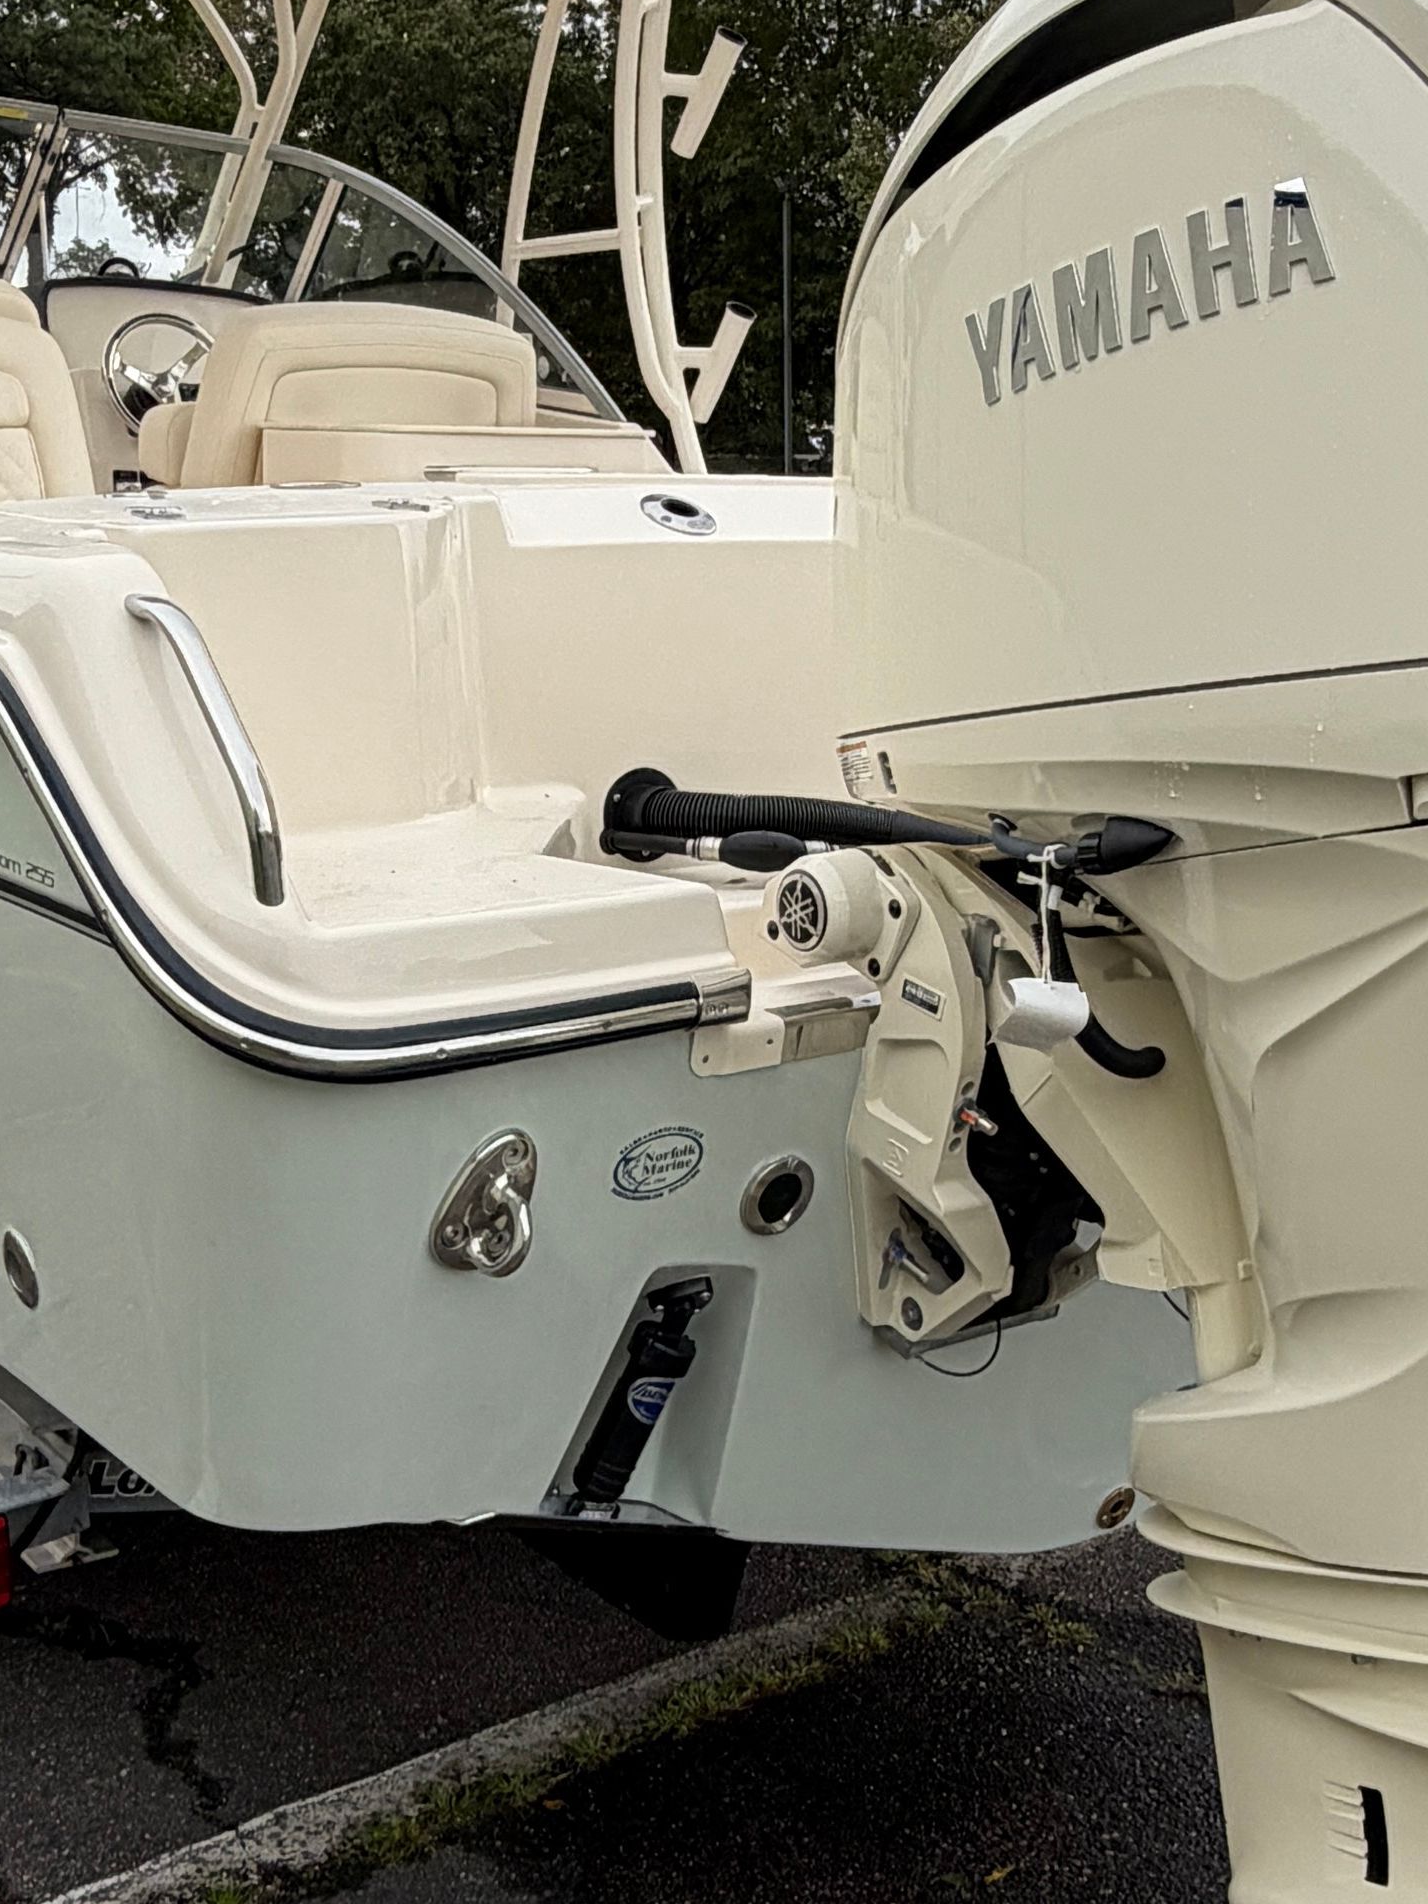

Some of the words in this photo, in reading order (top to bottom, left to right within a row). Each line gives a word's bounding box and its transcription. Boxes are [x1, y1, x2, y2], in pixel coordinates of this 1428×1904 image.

[964, 177, 1336, 407] YAMAHA
[26, 861, 54, 888] 255
[644, 1143, 696, 1163] Norfolk
[642, 1158, 692, 1176] Marine
